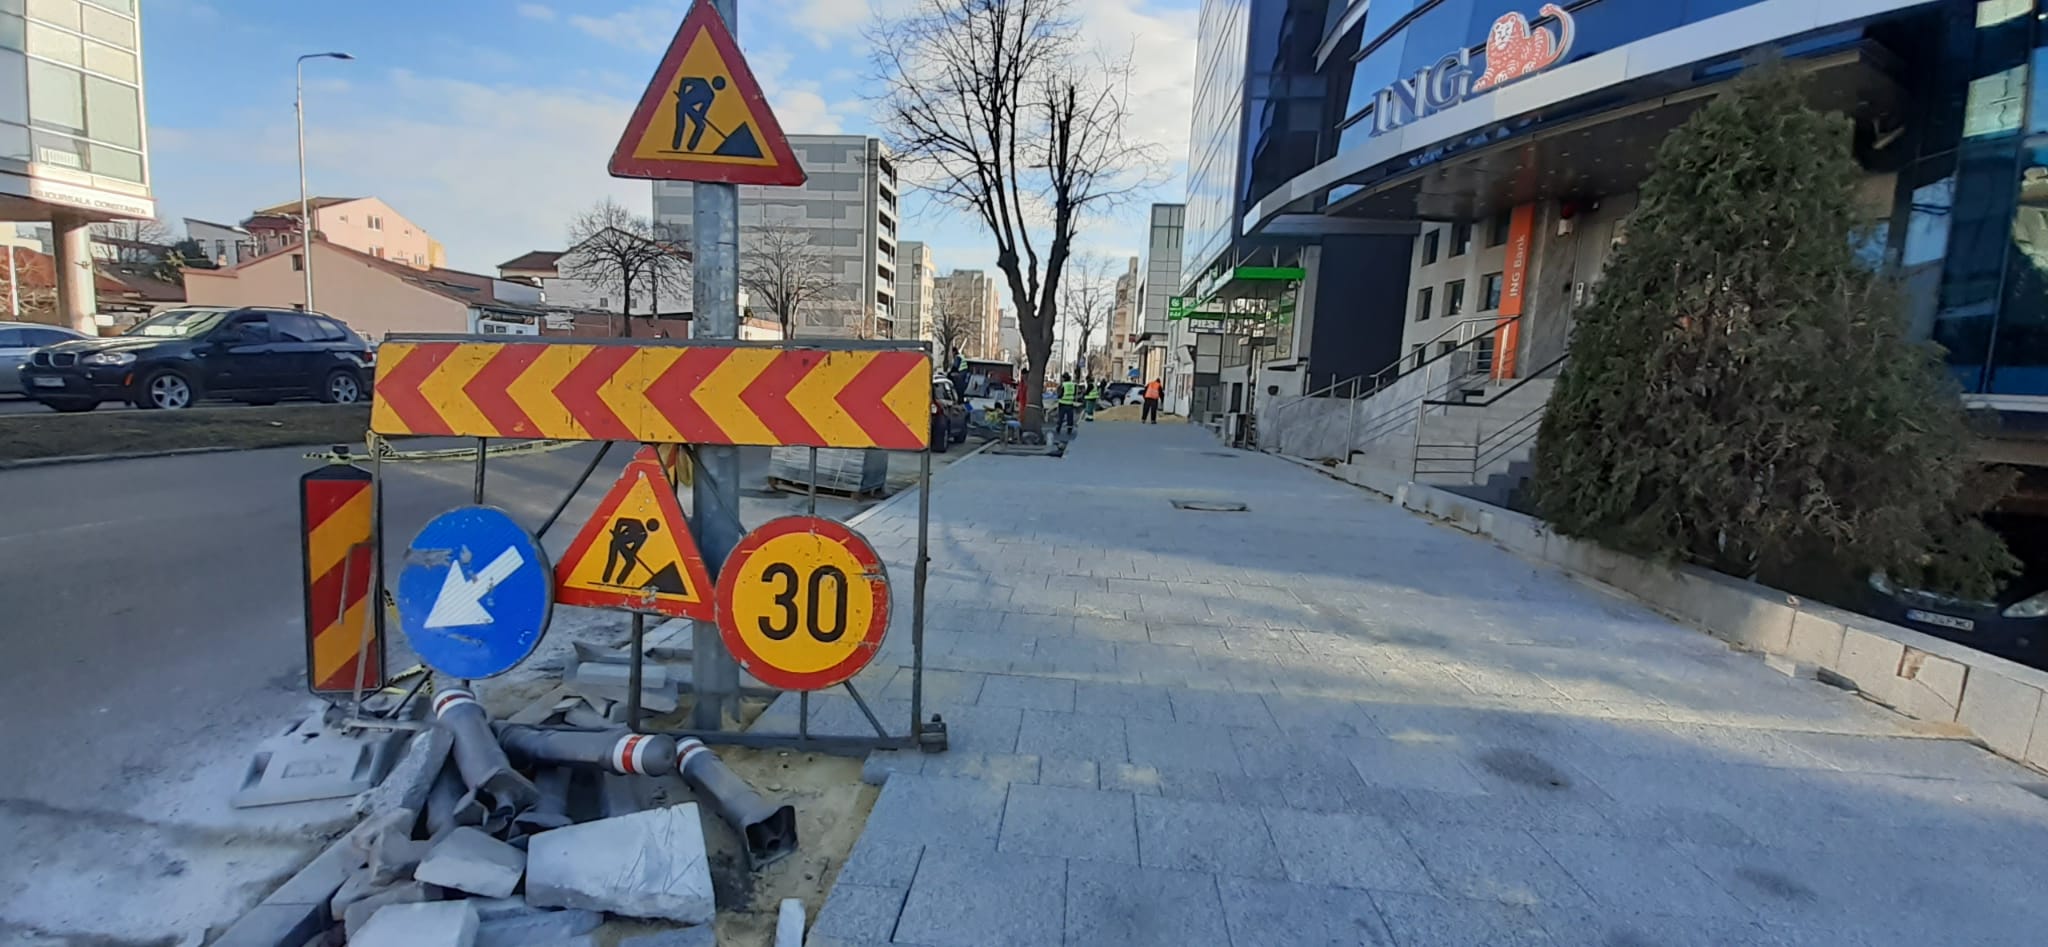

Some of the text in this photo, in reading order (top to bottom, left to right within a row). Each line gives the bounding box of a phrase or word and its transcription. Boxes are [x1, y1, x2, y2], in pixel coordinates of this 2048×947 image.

[1368, 47, 1473, 137] ING
[1509, 234, 1526, 297] ING Bank
[758, 562, 848, 643] 30
